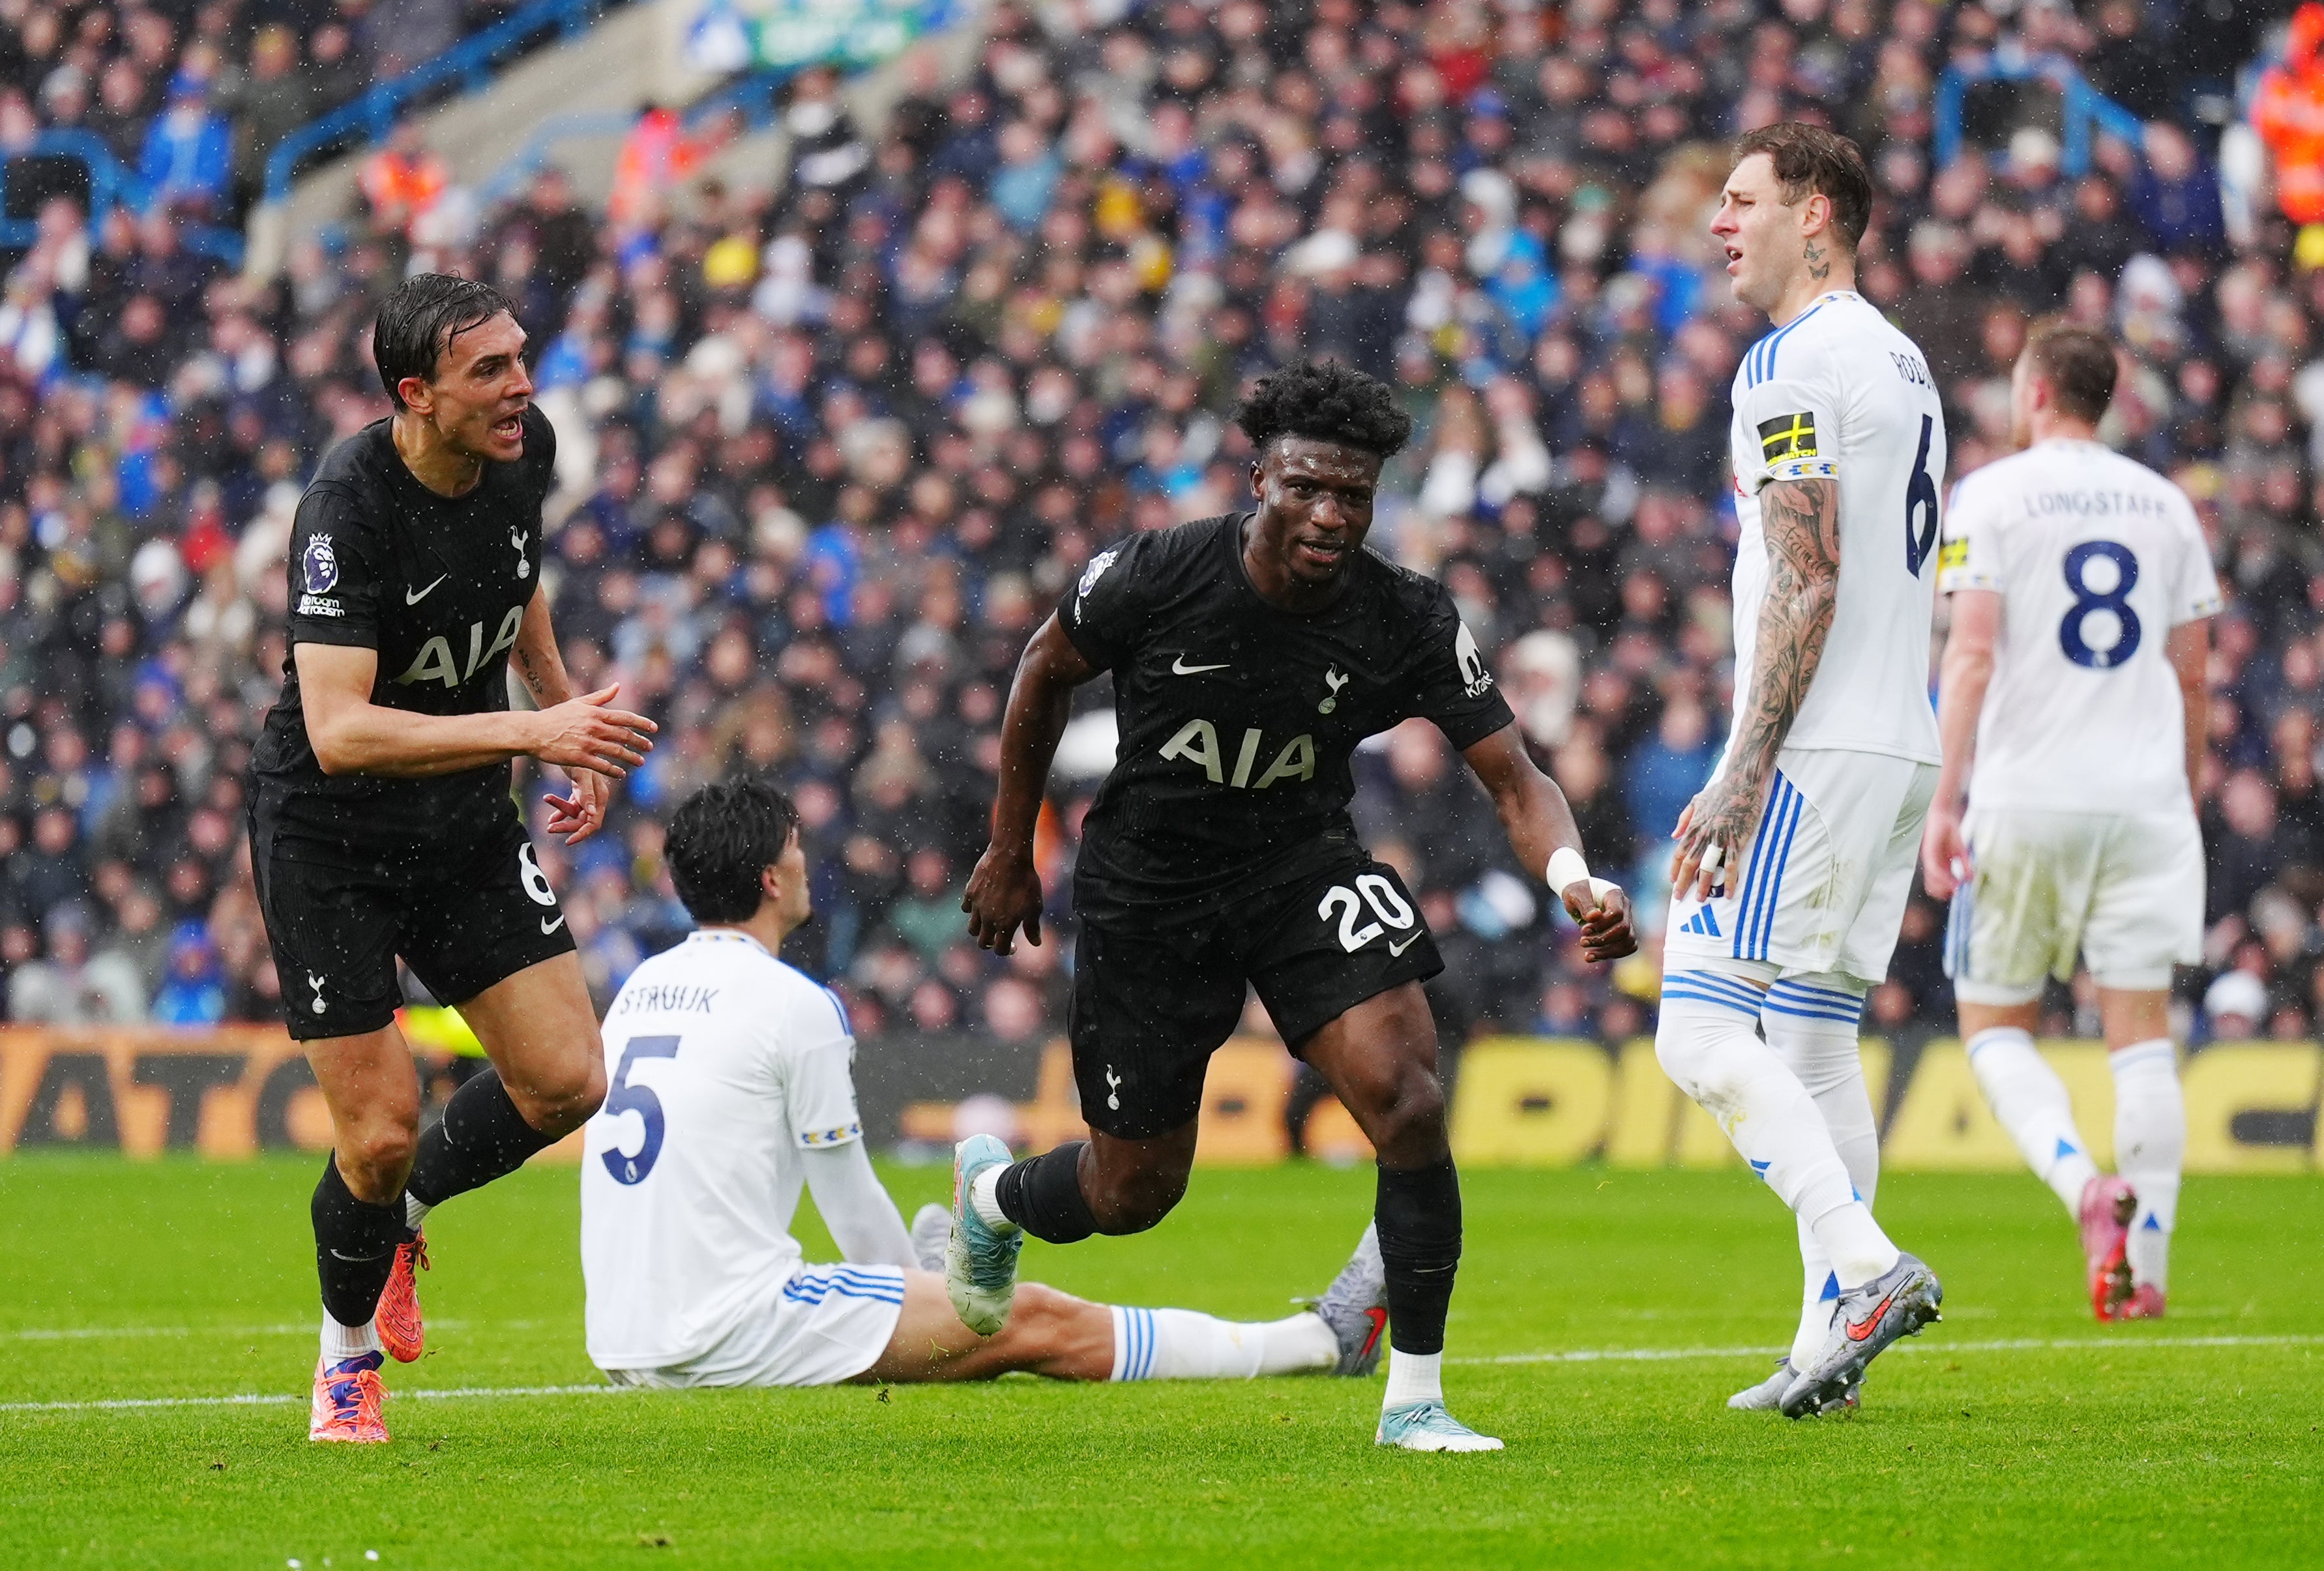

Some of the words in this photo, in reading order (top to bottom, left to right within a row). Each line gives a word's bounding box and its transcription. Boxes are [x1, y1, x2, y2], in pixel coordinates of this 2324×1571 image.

[1906, 413, 1937, 580] 6
[2023, 491, 2166, 519] LONGSTAFF
[311, 606, 345, 617] racism
[312, 596, 340, 608] room
[2059, 540, 2141, 669] 8
[392, 605, 523, 689] AIA
[1158, 718, 1316, 789] AIA
[518, 842, 557, 906] 6
[1317, 874, 1415, 953] 20
[620, 985, 720, 1014] STRUIJK
[602, 1035, 682, 1185] 5
